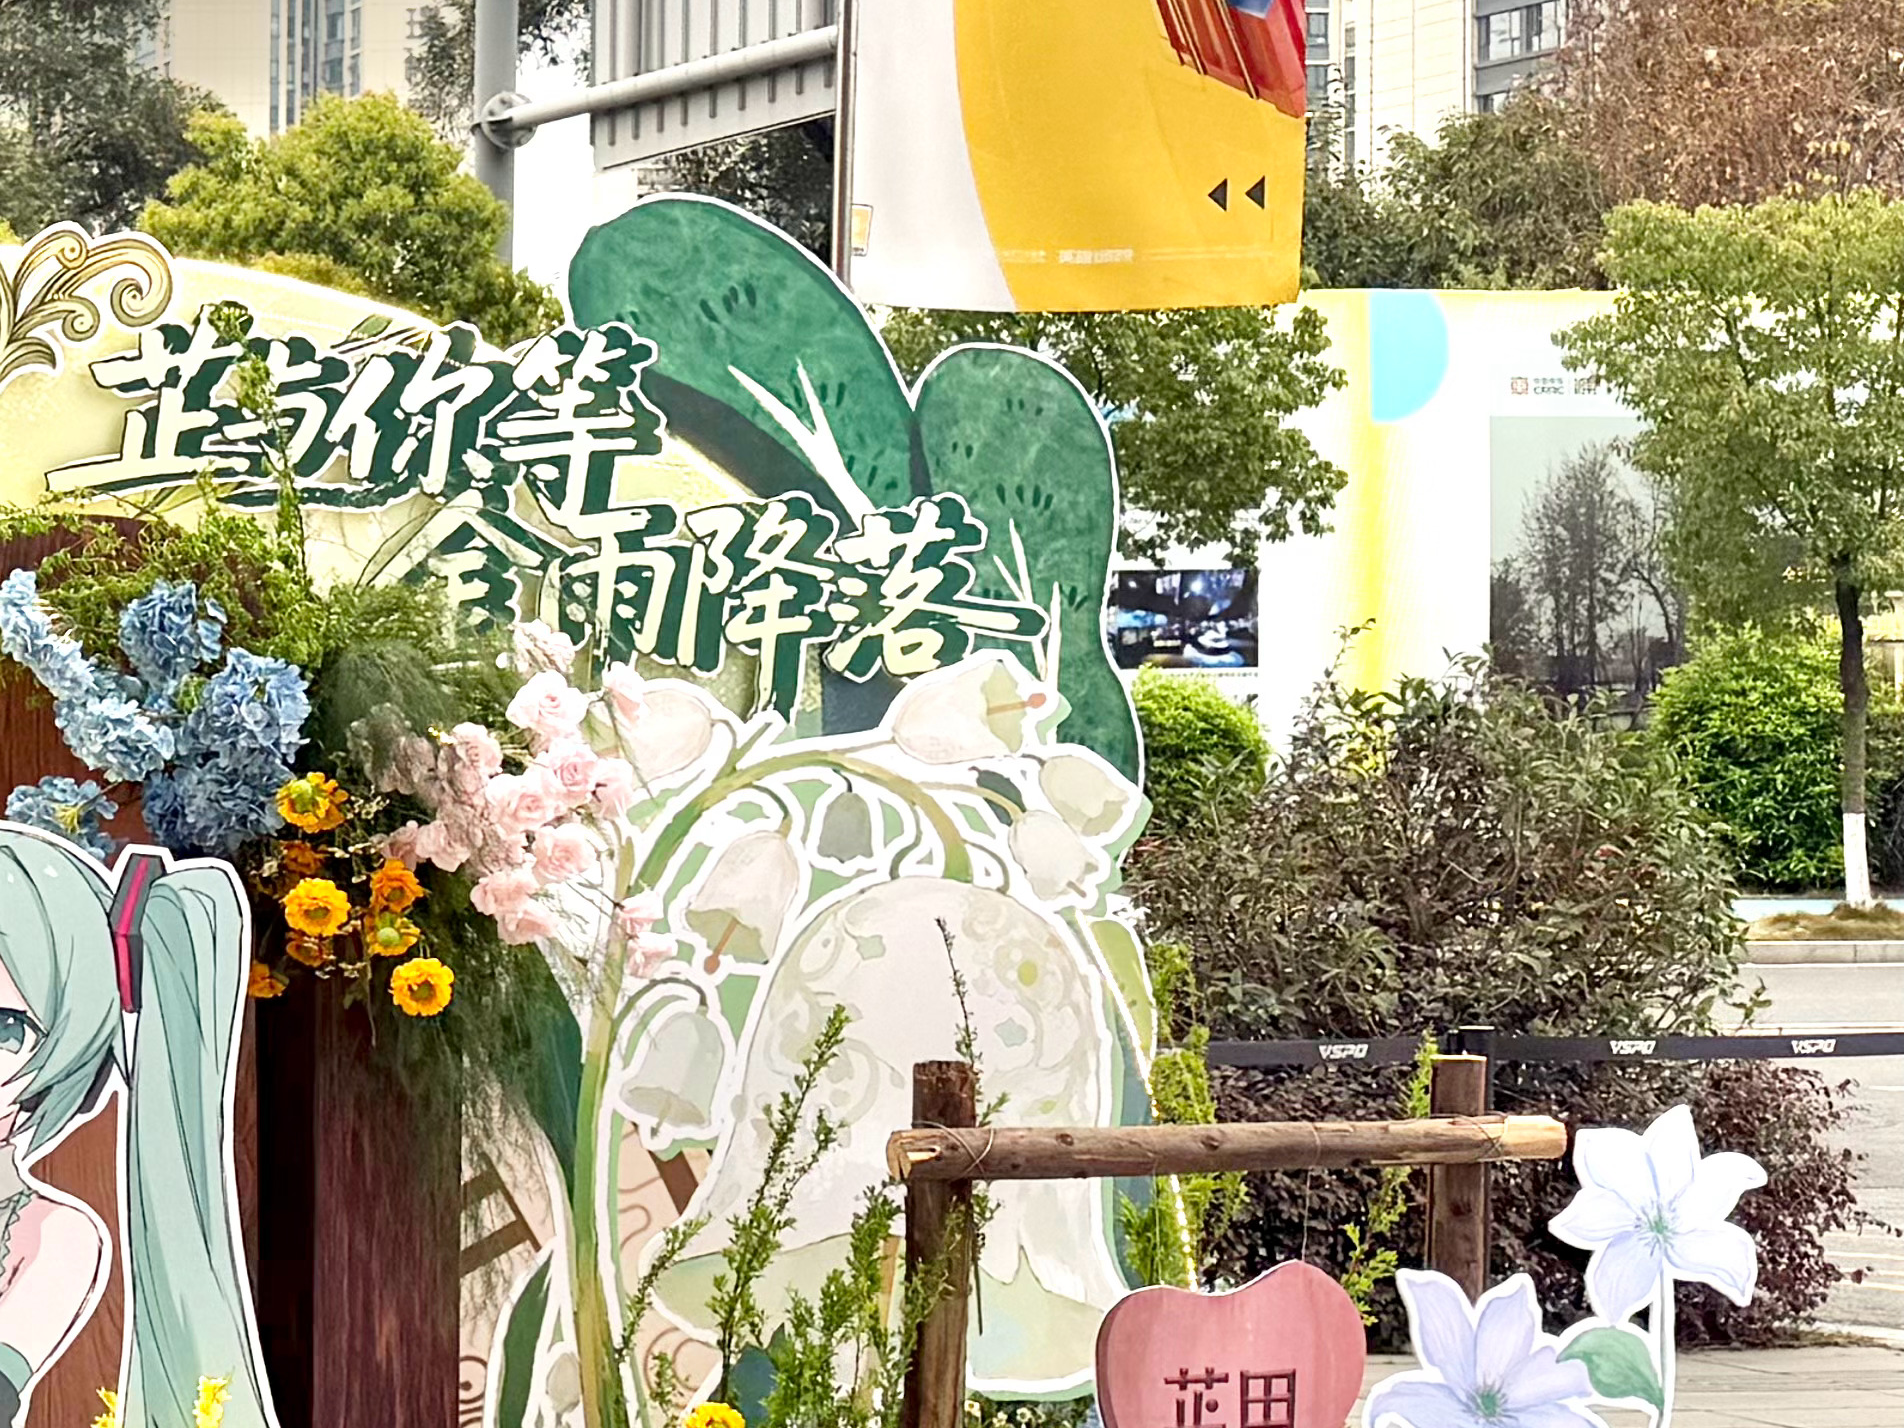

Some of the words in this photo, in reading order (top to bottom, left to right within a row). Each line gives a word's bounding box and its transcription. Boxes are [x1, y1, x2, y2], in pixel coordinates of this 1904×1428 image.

[46, 326, 656, 518] 芷与你等
[1318, 1044, 1369, 1061] VSPO
[1609, 1039, 1656, 1056] VSPO
[1790, 1038, 1836, 1055] VSPO
